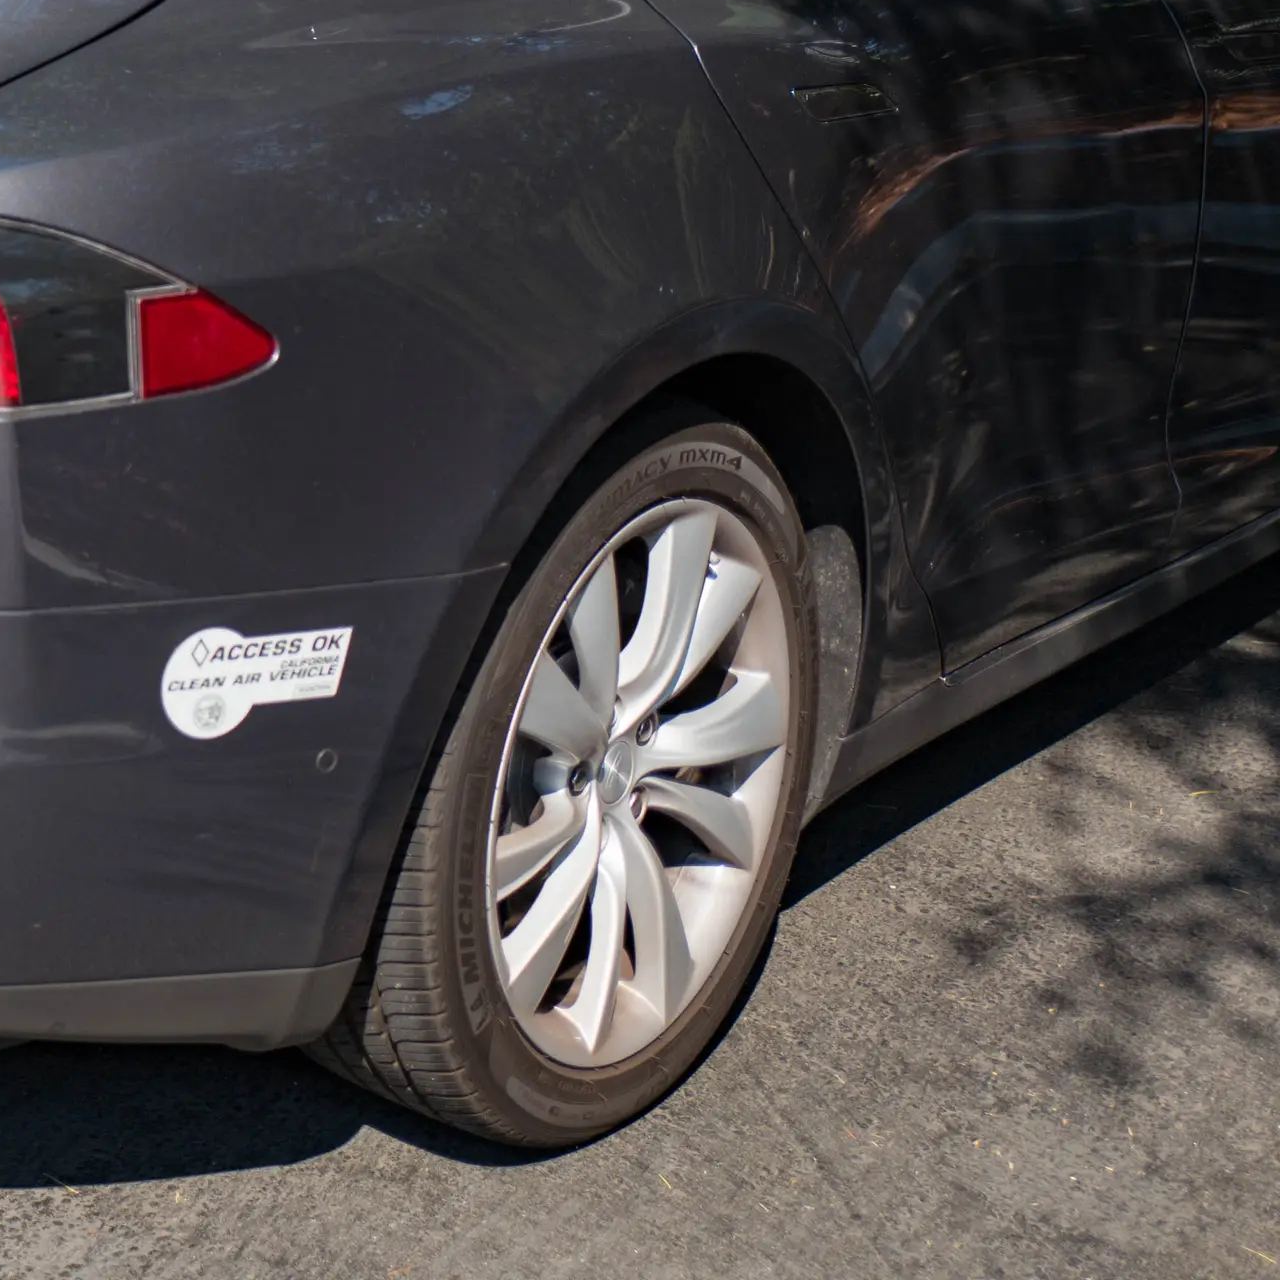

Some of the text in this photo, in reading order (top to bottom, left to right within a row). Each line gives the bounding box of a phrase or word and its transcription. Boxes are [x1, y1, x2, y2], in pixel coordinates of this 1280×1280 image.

[209, 633, 345, 663] ACCESS OK
[167, 663, 339, 692] CLEAN AIR VEHICLE
